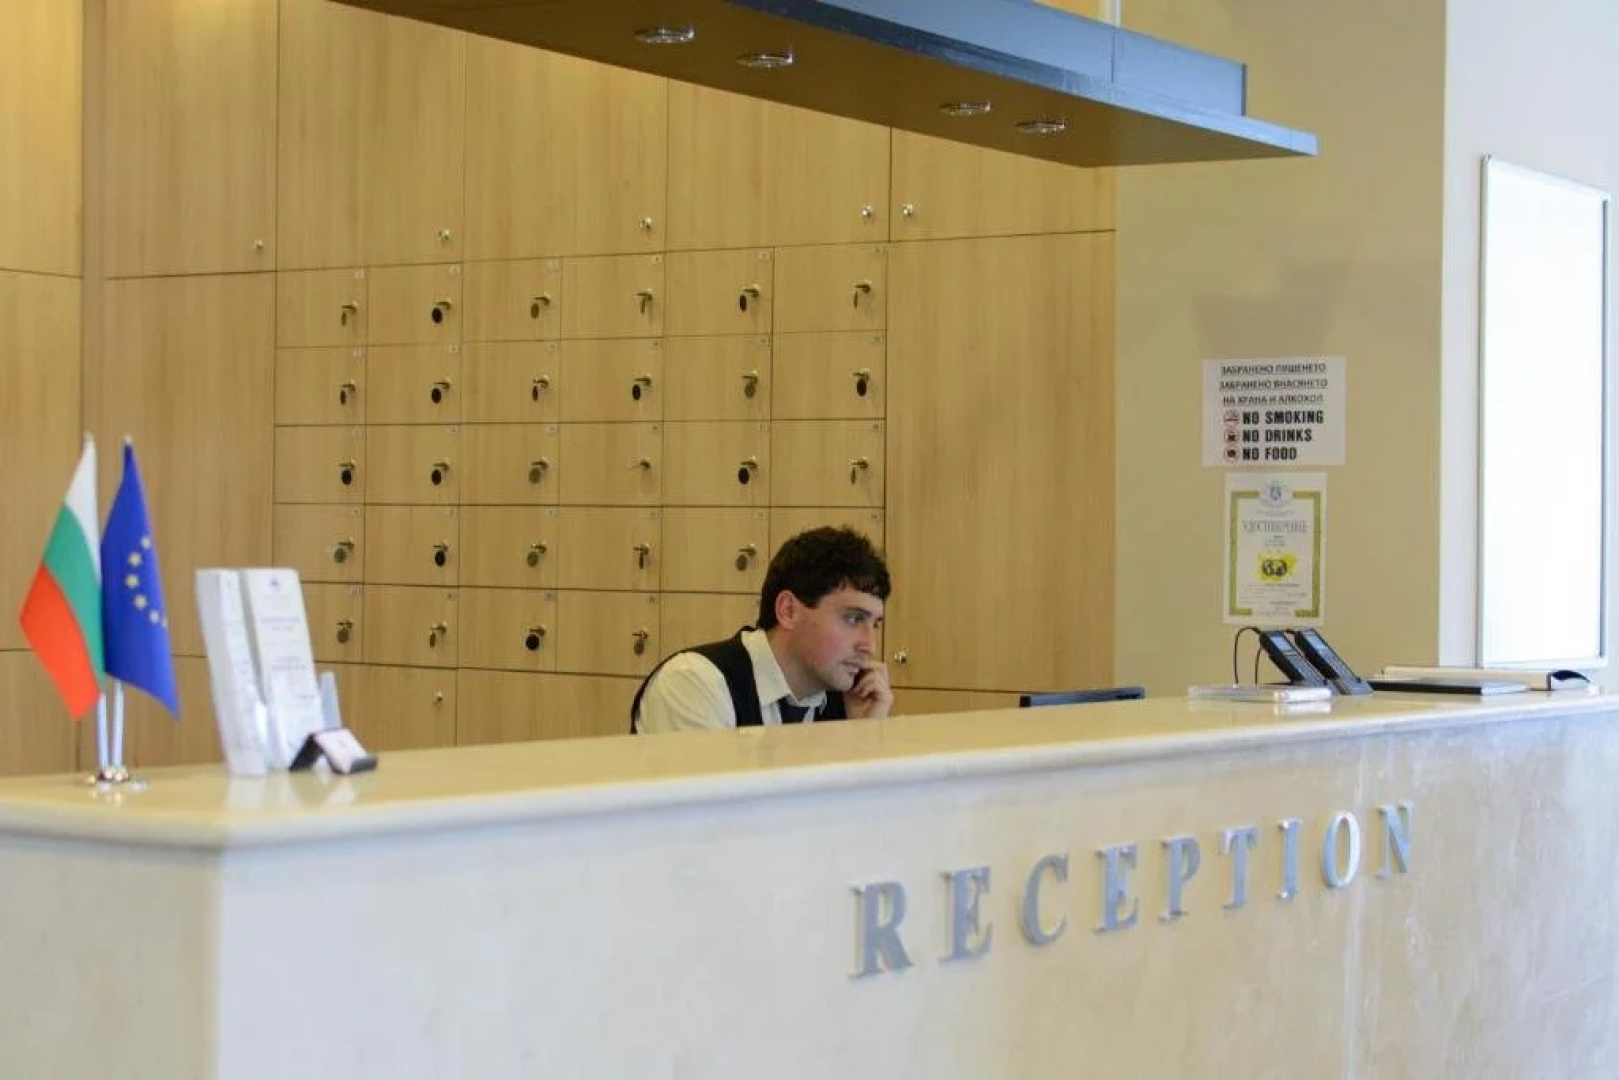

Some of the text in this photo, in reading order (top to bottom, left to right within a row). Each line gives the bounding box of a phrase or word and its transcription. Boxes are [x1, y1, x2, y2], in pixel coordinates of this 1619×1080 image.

[1221, 363, 1326, 375] ЗАБРАНЕНО ПУШЕНЕТО
[1220, 380, 1272, 390] ЗАБРАНЕНО
[1223, 396, 1235, 406] НА
[1278, 394, 1323, 404] АЛКОХОЛ
[1242, 410, 1324, 425] NO SMOKING
[1242, 428, 1312, 442] NO DRINKS
[1242, 446, 1297, 460] NO FOOD
[849, 801, 1416, 981] RECEPTION
